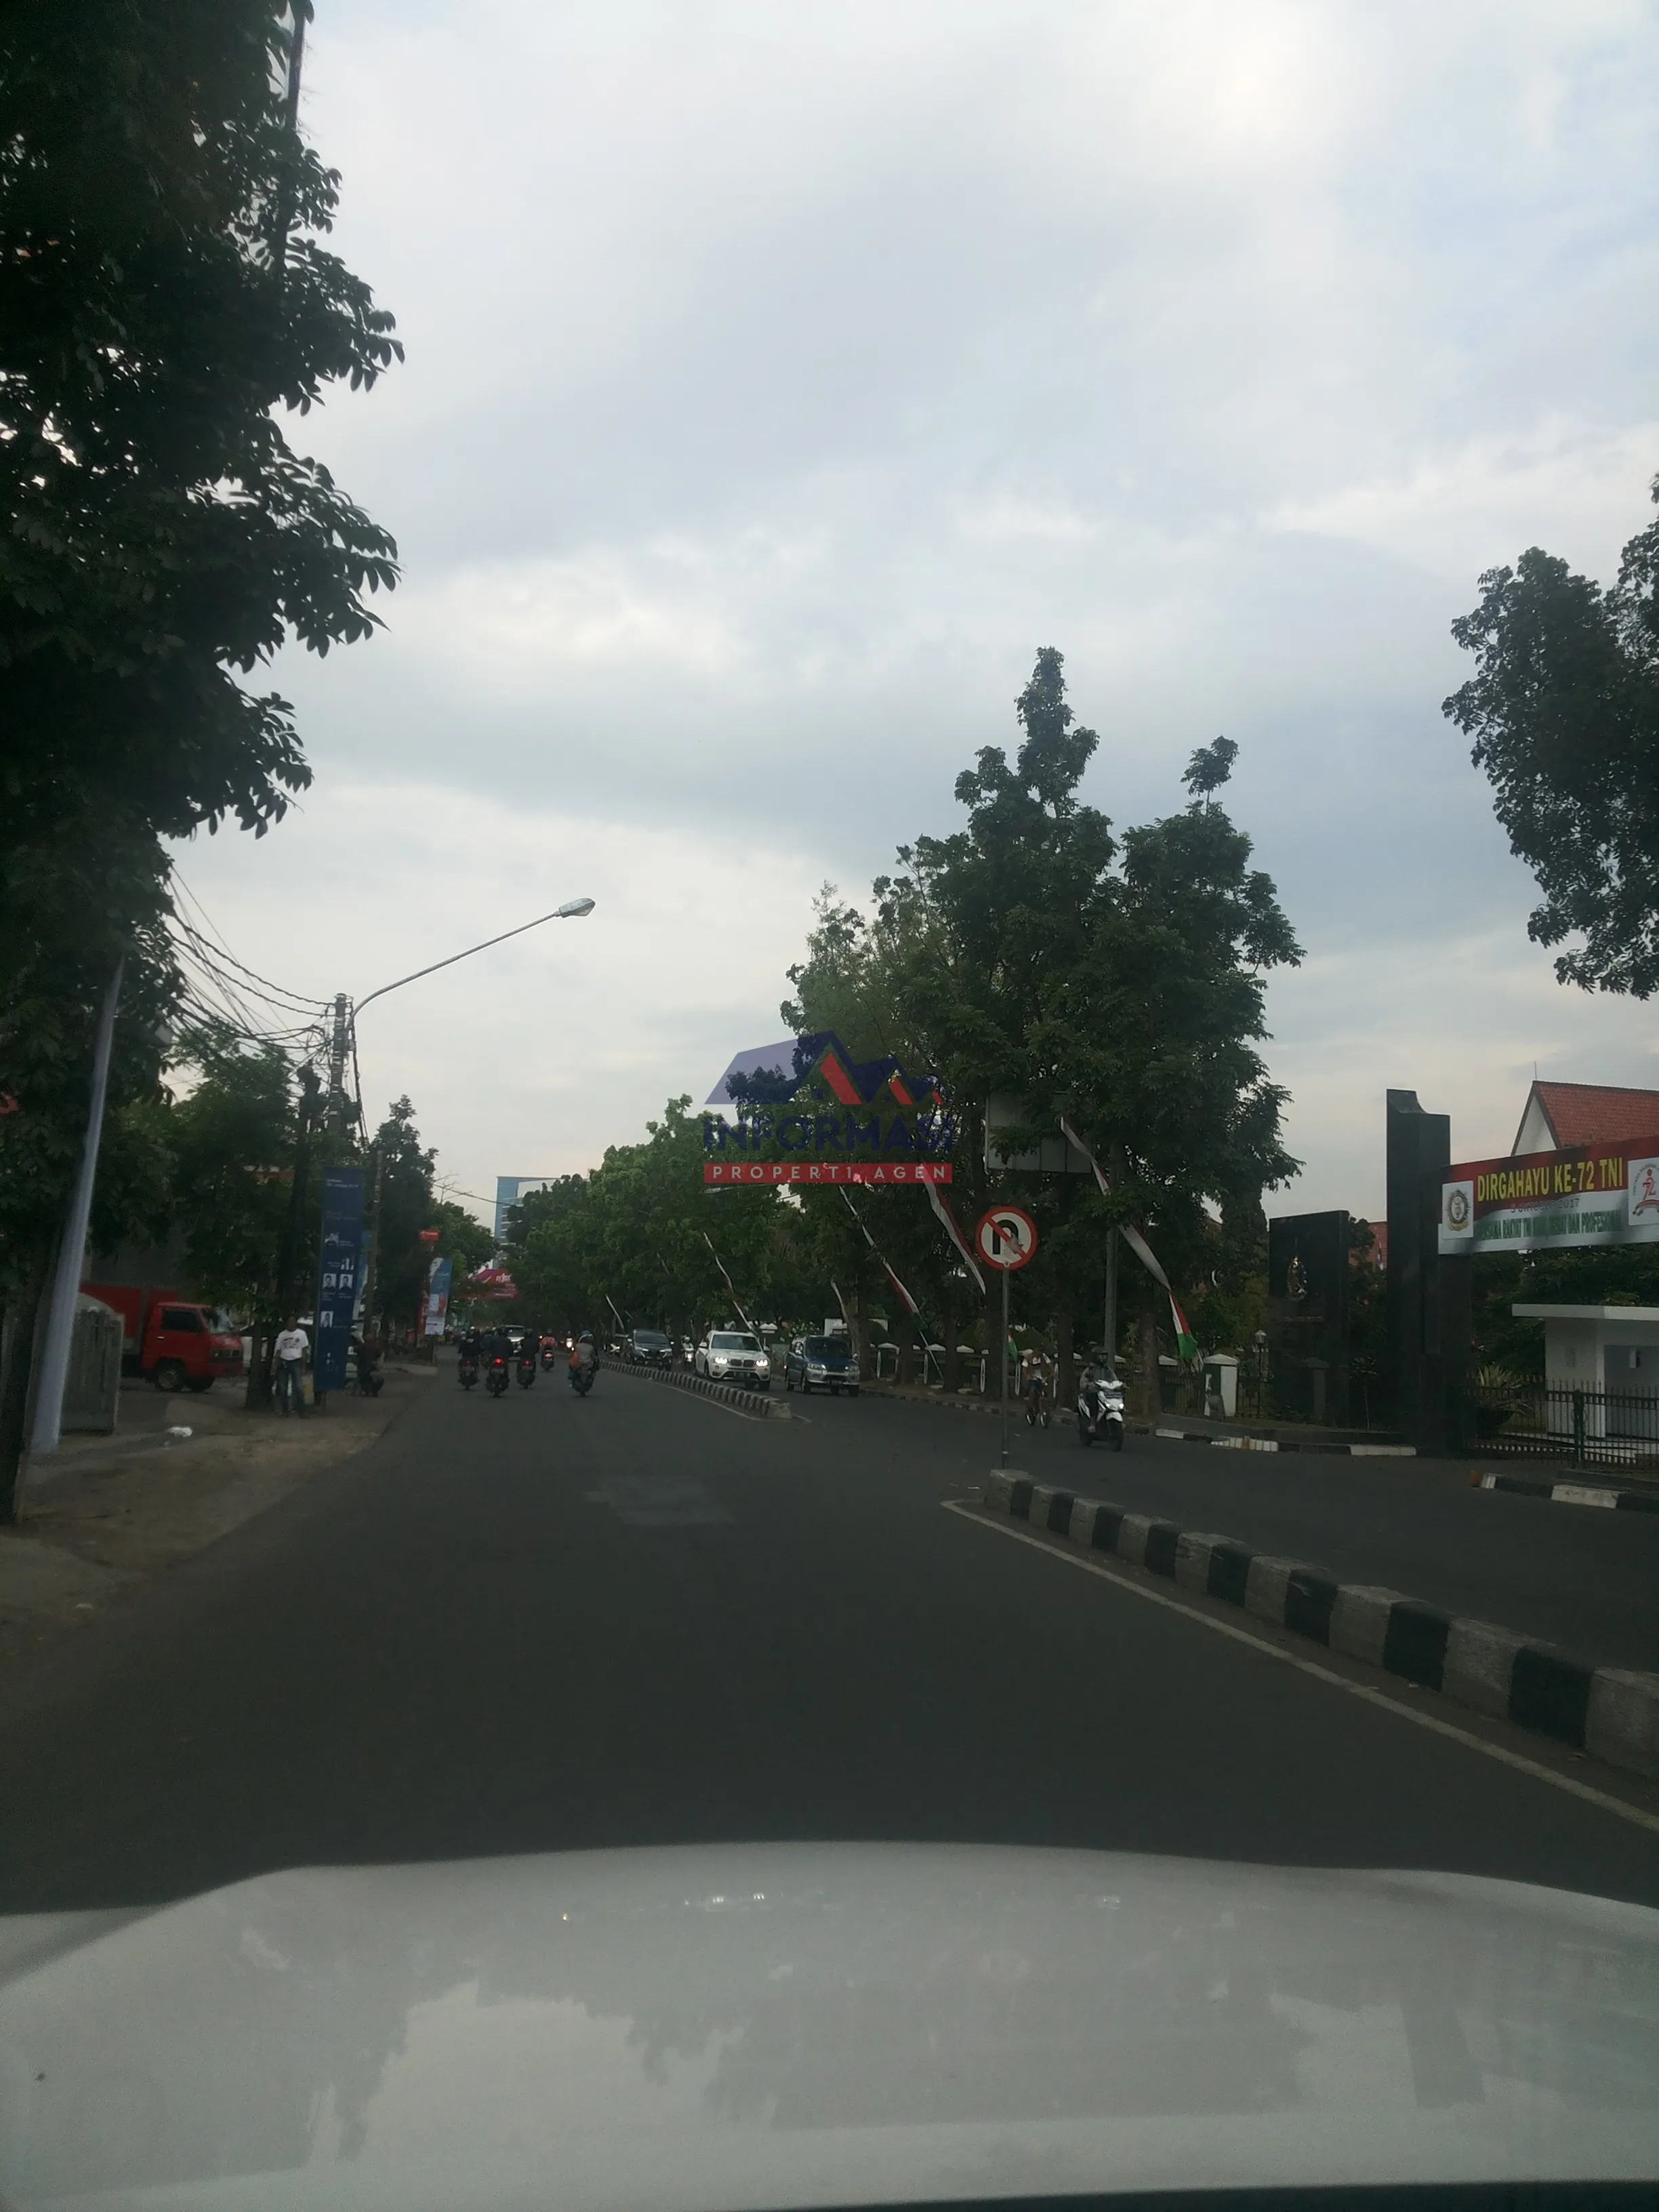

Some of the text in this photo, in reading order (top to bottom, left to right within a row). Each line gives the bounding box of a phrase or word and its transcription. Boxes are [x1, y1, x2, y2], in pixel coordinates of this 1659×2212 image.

[1477, 1167, 1549, 1202] DIRGAHAYU
[1555, 1160, 1595, 1193] KE-72
[1599, 1157, 1624, 1189] TNI
[1558, 1197, 1580, 1210] 2017
